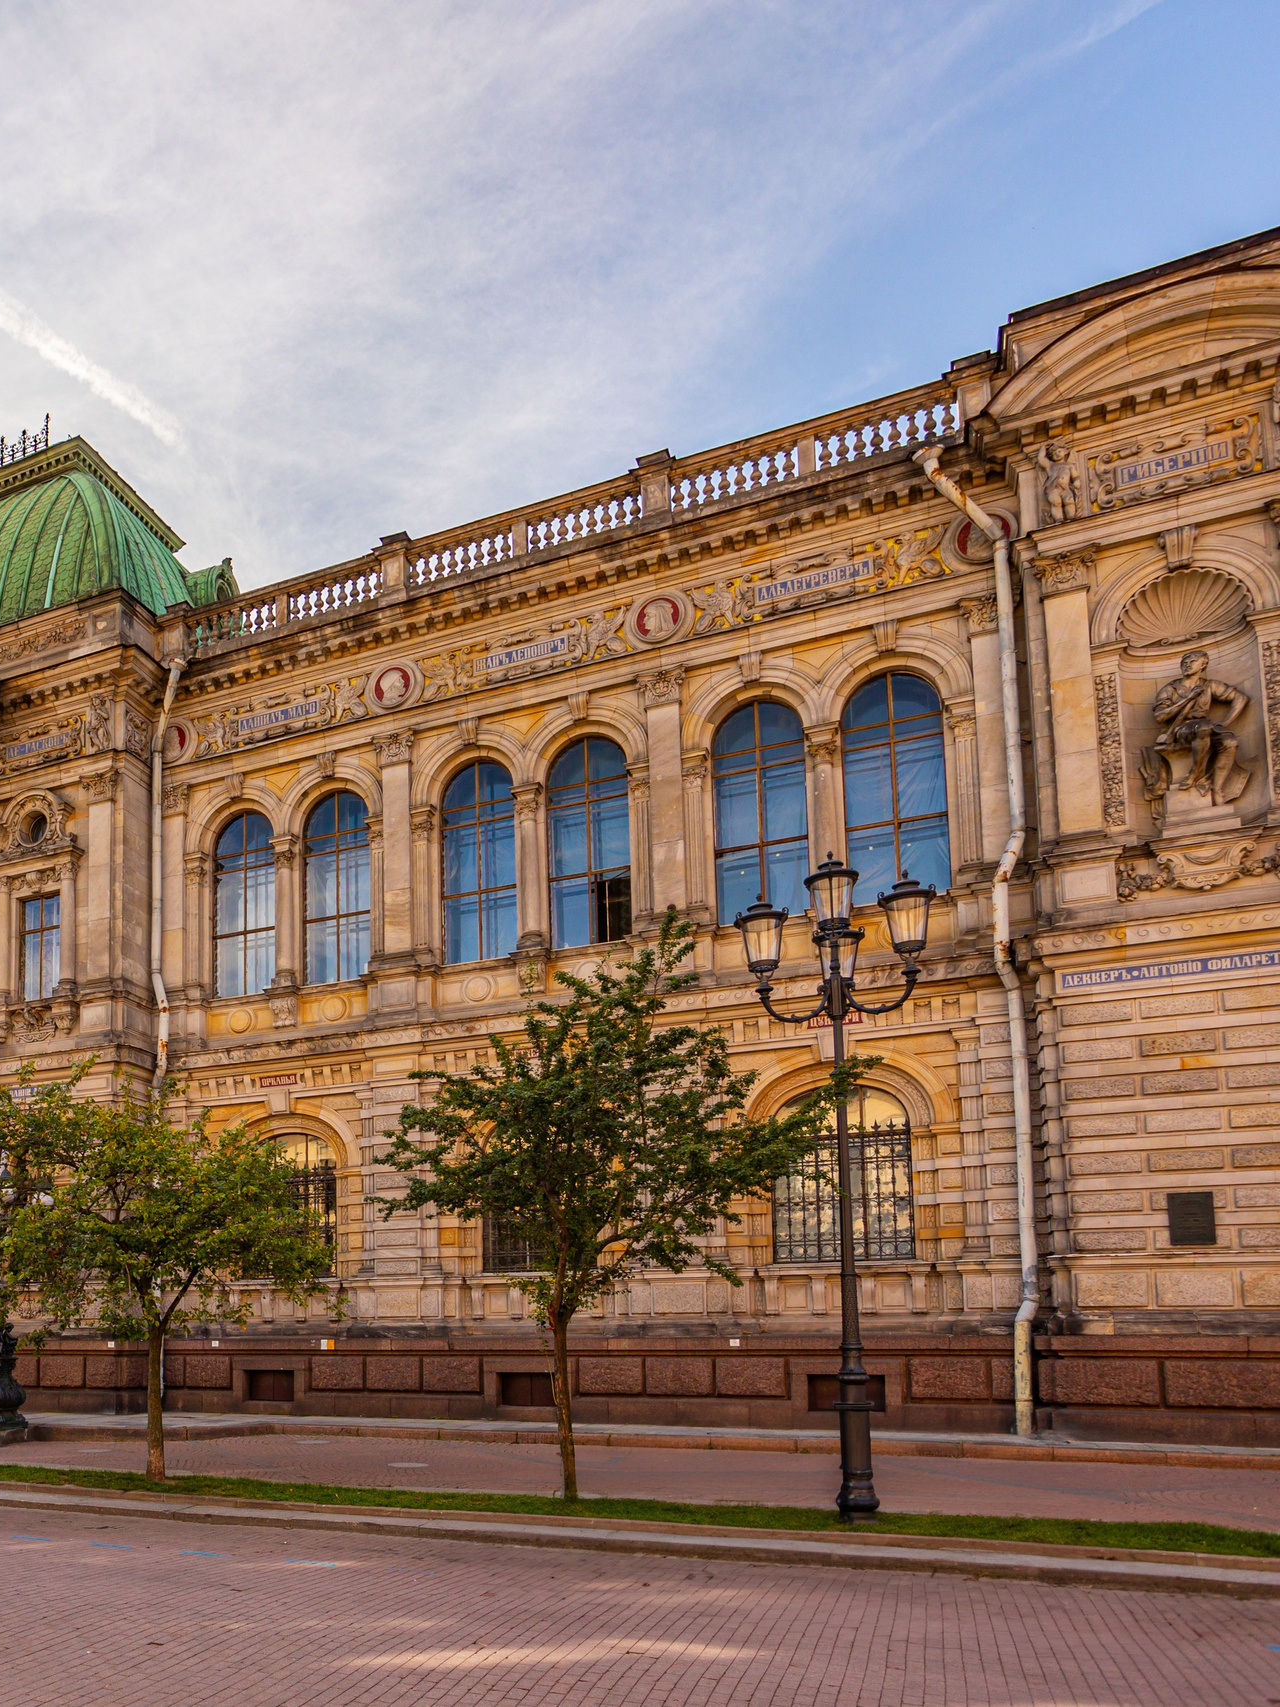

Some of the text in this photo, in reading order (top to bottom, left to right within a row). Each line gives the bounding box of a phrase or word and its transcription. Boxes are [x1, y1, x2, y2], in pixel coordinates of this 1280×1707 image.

[760, 562, 868, 600] АЛЬДЕГРЕВЕРЪ
[287, 702, 316, 720] МАРО
[1064, 970, 1131, 988] ДЕККЕРЪ
[261, 1075, 296, 1087] ОРКАНЬЯ
